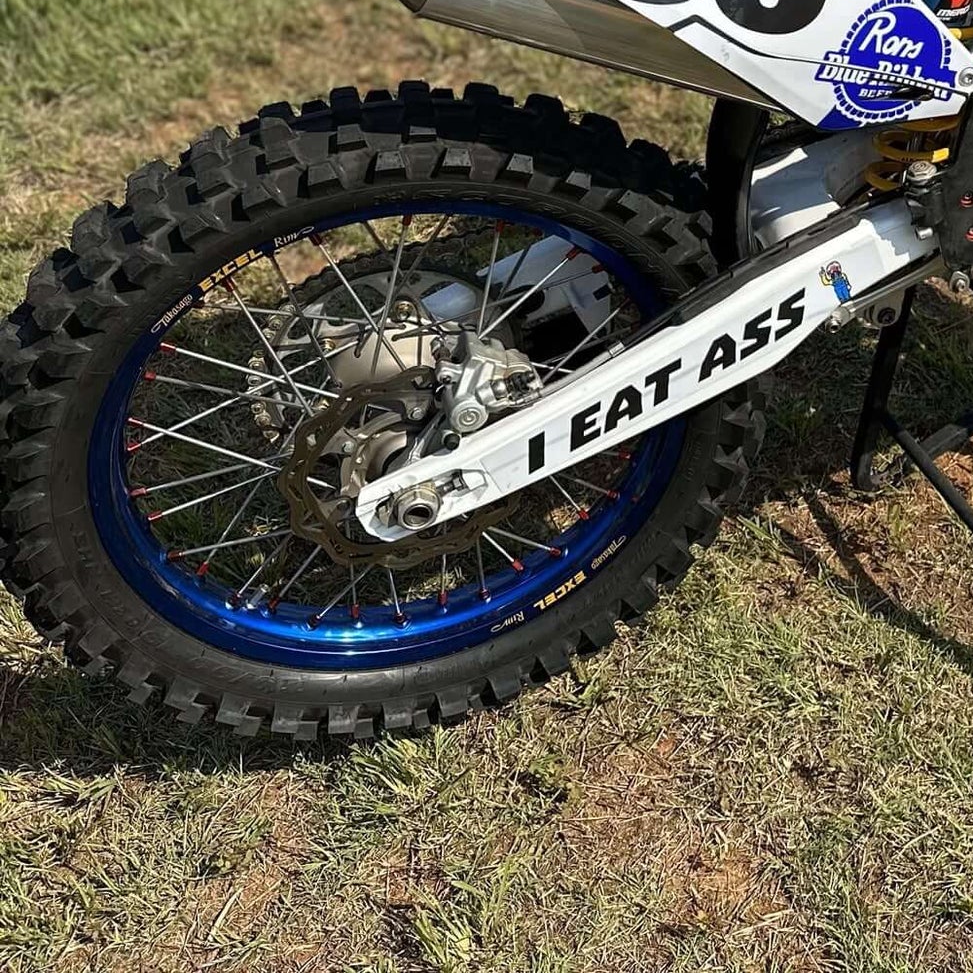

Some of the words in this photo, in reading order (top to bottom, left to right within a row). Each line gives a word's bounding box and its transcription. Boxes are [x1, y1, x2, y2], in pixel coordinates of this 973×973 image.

[859, 11, 925, 60] Rons
[818, 51, 872, 85] Blue
[866, 60, 952, 100] Ribbon
[151, 294, 193, 333] Takasago
[198, 248, 263, 292] EXCEL
[273, 226, 315, 248] Rim
[528, 430, 546, 475] I
[570, 357, 682, 453] EAT
[698, 287, 806, 383] ASS
[533, 570, 588, 611] EXCEL
[490, 611, 525, 633] Rim
